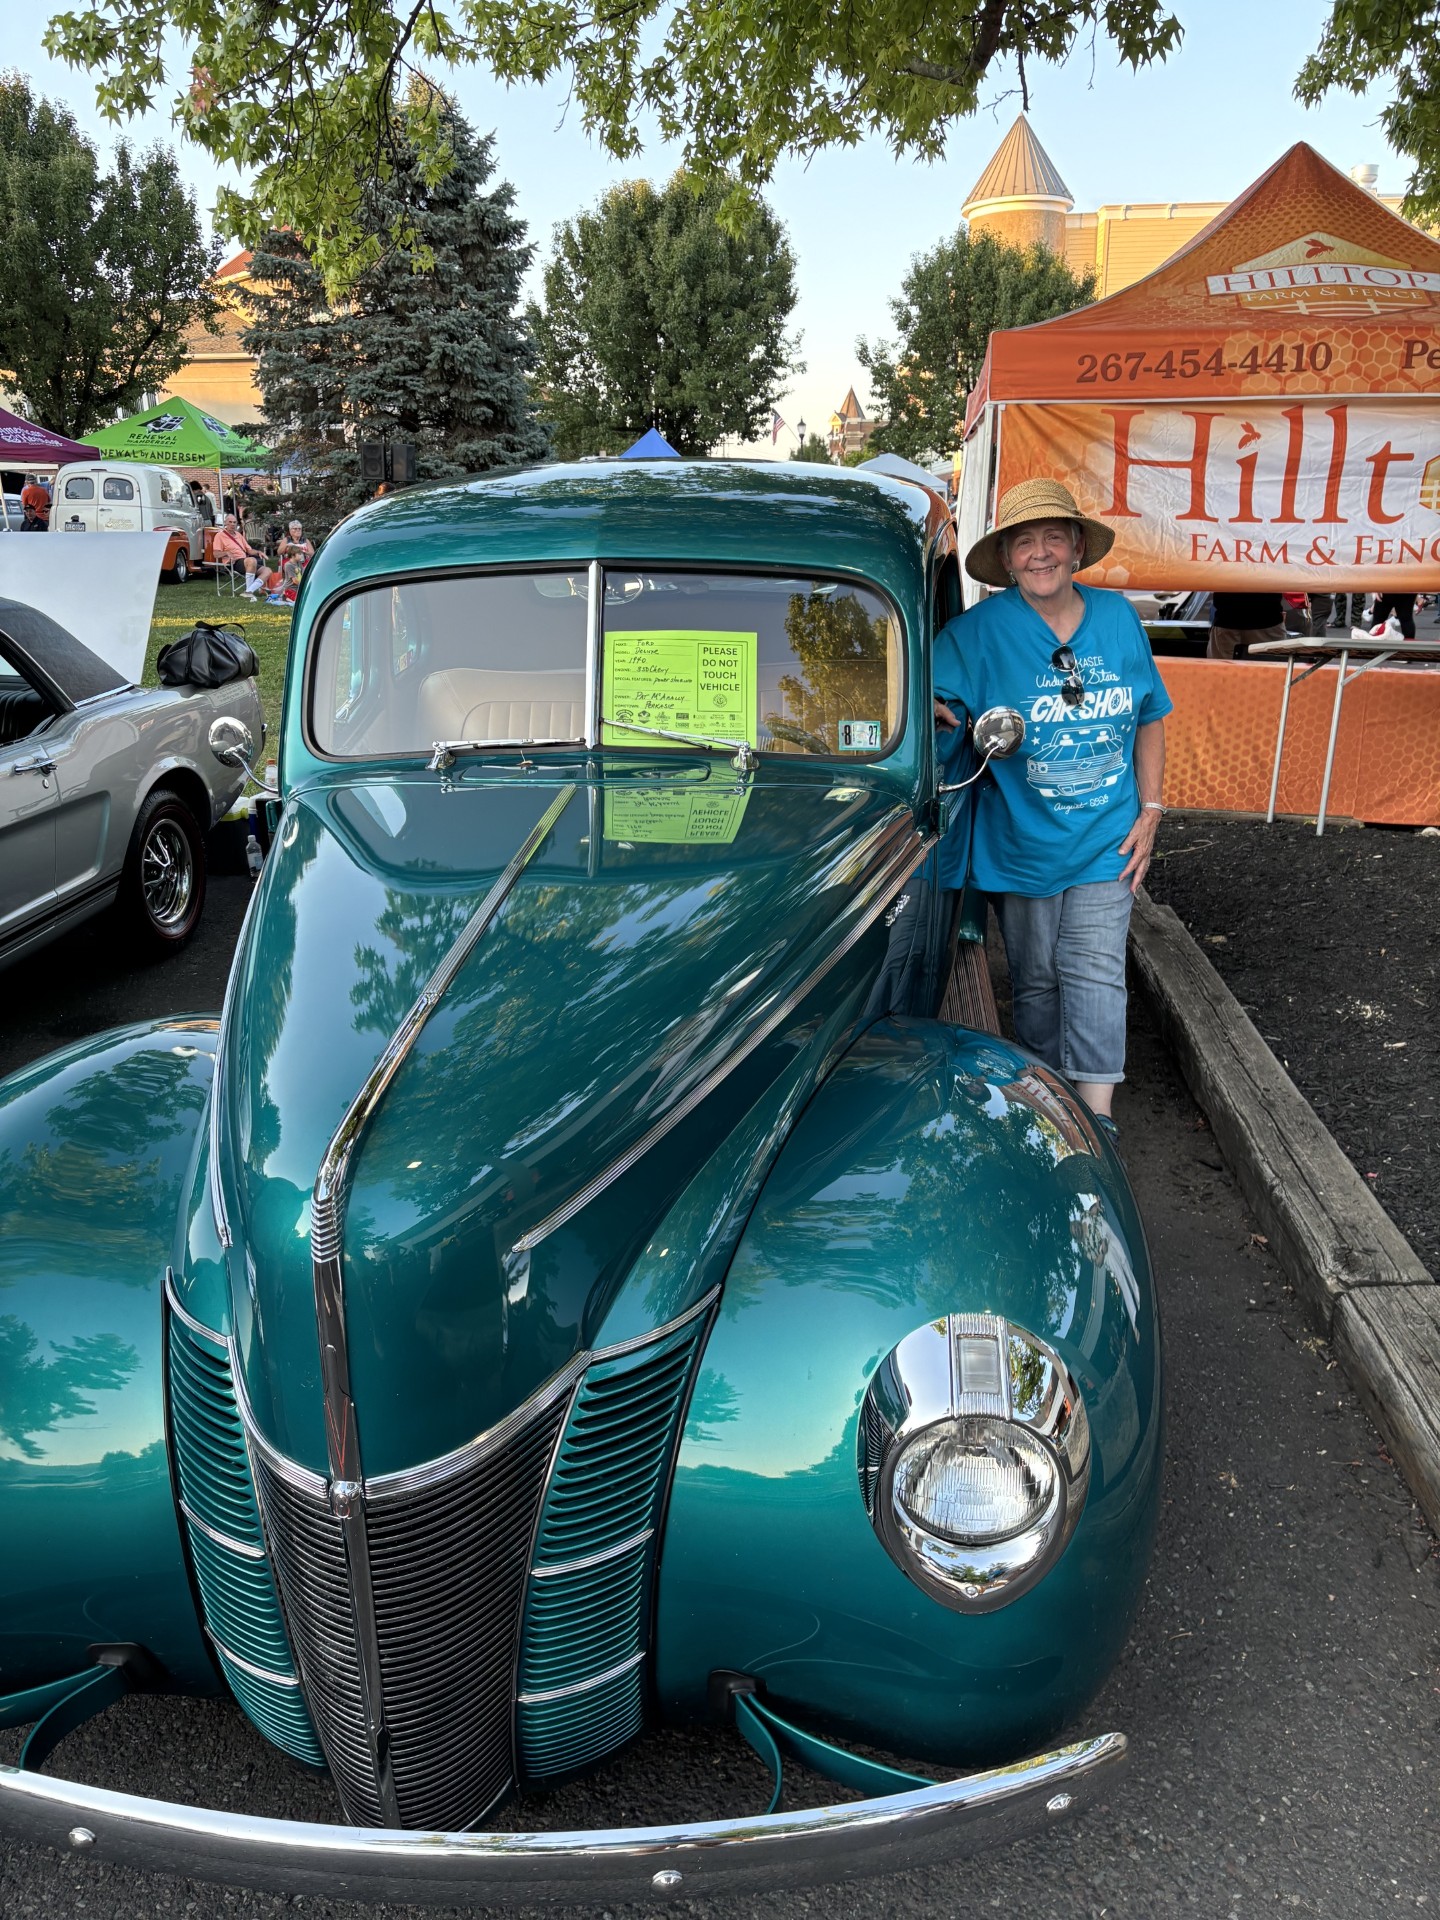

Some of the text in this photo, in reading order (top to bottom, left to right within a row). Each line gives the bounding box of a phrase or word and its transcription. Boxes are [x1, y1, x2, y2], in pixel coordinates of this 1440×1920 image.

[1223, 264, 1428, 292] HILLTOP
[1246, 286, 1423, 302] FARM & FENCE
[1076, 339, 1440, 383] 267-454-4410 Pe
[128, 433, 178, 441] RENEWAL
[140, 450, 149, 458] by
[149, 451, 206, 462] ANDERSEN
[1189, 533, 1291, 565] FARM
[1305, 535, 1338, 567] &
[703, 647, 738, 656] PLEASE
[629, 656, 647, 664] 1940
[702, 659, 717, 667] DO
[703, 671, 737, 679] TOUCH
[1086, 667, 1121, 685] Stars
[700, 683, 740, 692] VEHICLE
[1078, 686, 1133, 718] SHOW
[843, 724, 852, 746] 8
[868, 725, 878, 746] 27
[1053, 801, 1088, 815] August
